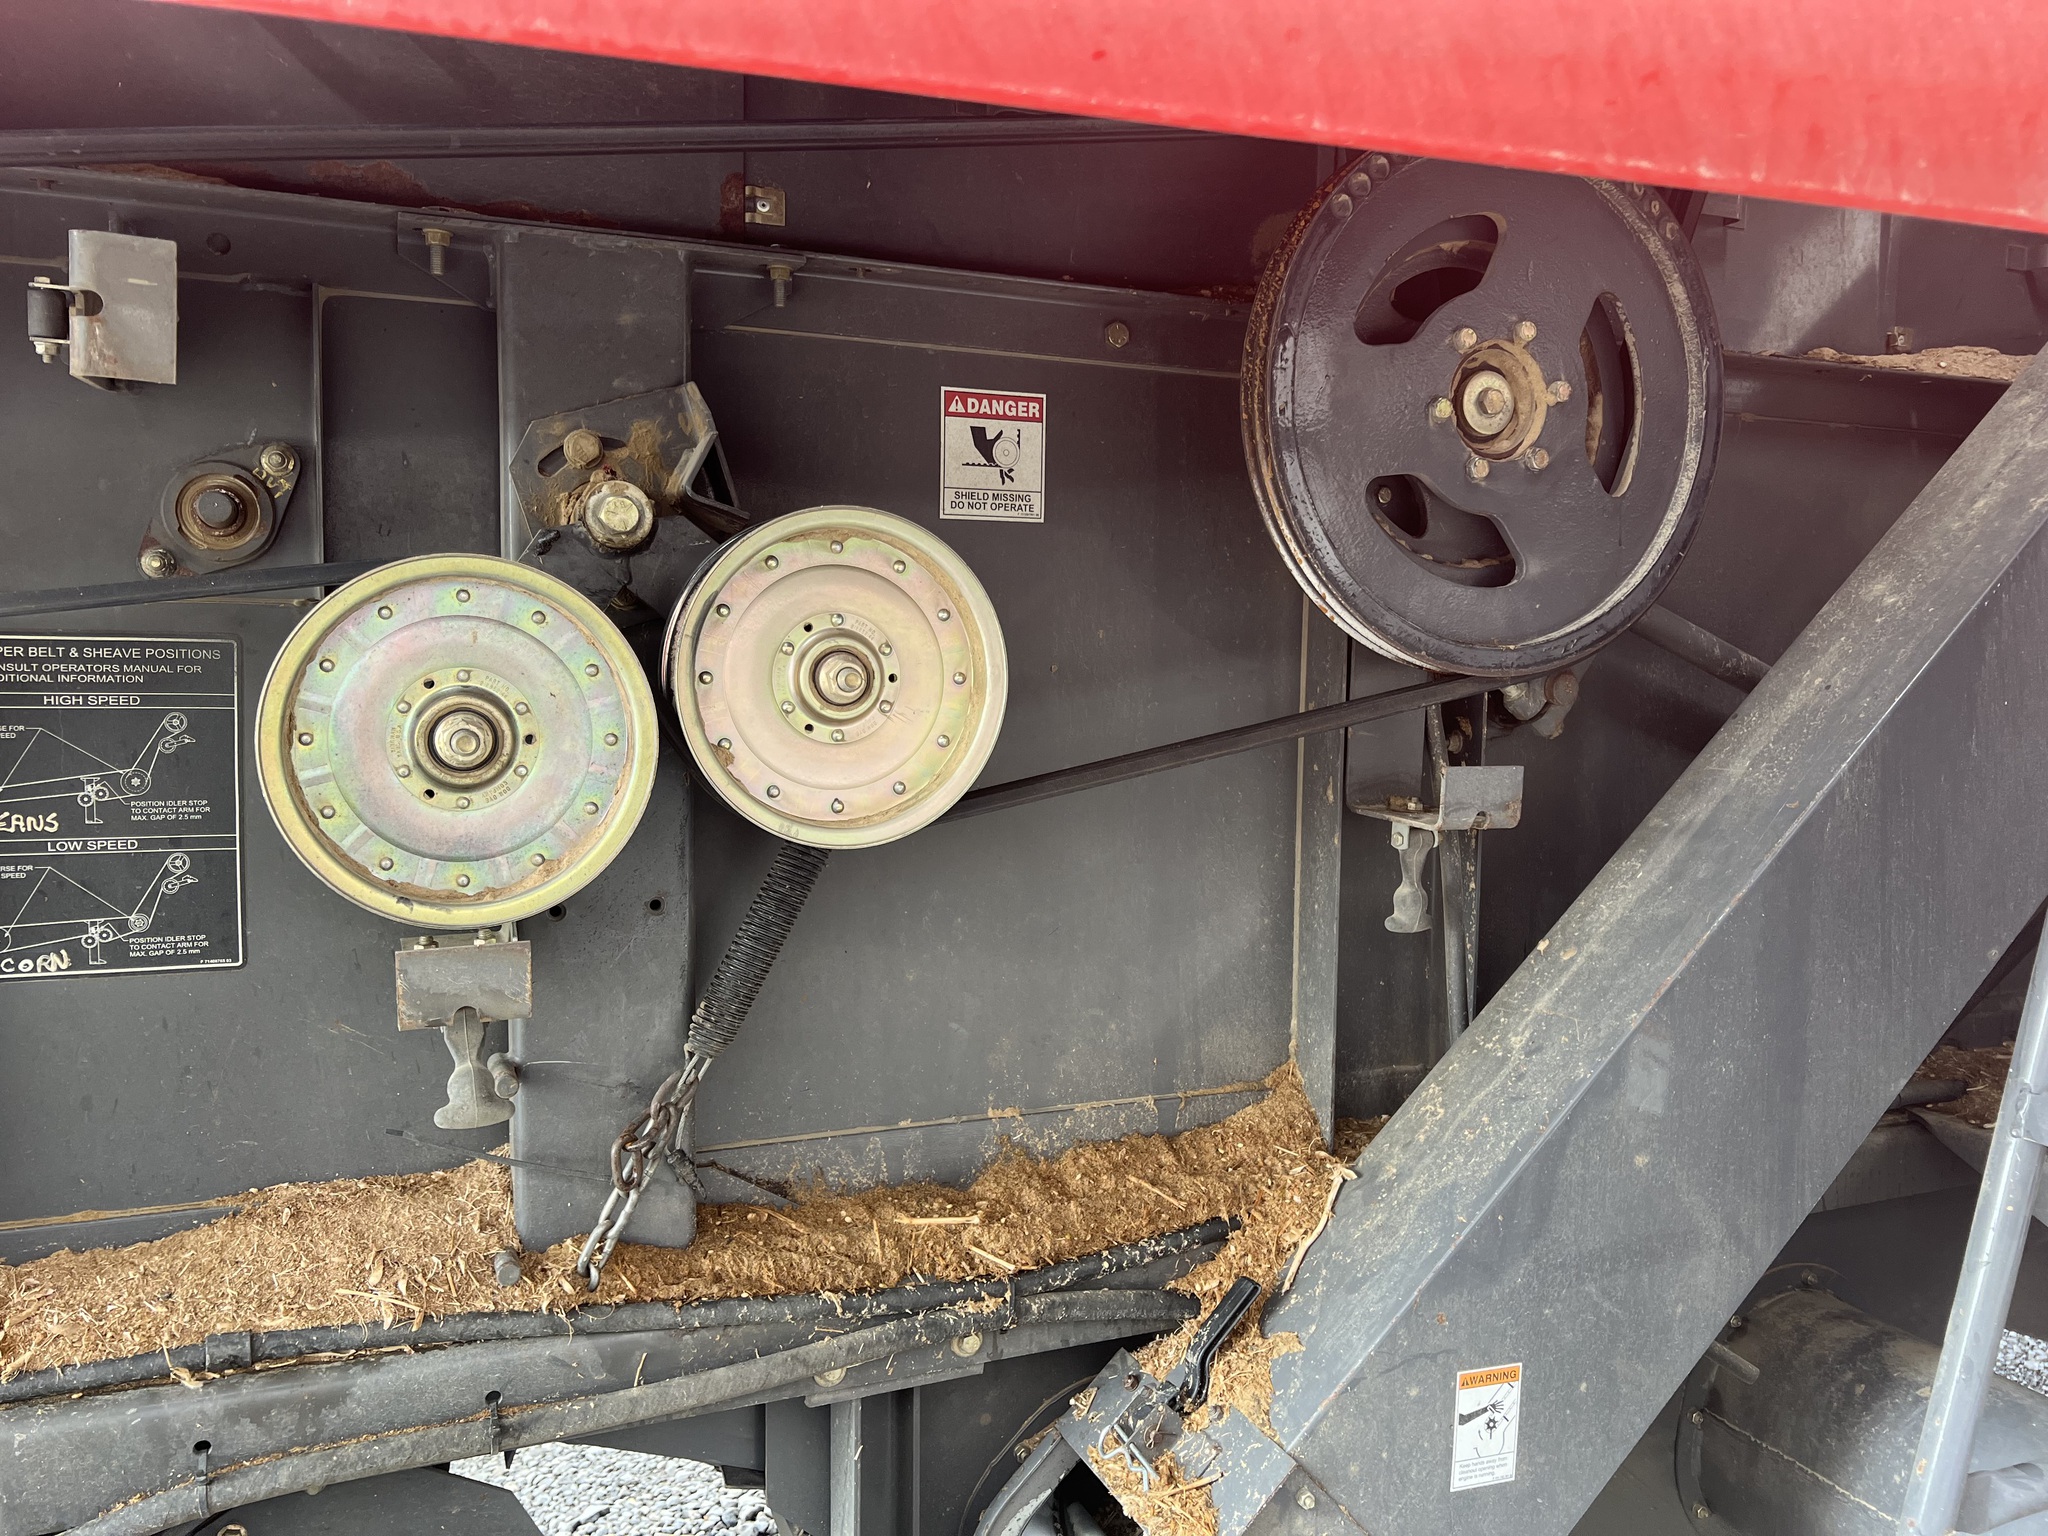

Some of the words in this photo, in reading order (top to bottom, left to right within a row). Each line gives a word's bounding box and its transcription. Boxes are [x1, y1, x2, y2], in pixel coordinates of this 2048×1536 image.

[967, 398, 1040, 418] DANGER
[954, 491, 989, 501] SHIELD
[992, 493, 1031, 503] MISSING
[950, 500, 964, 510] DO
[967, 502, 988, 511] NOT
[990, 502, 1035, 512] OPERATE
[28, 647, 65, 658] BELT
[69, 647, 79, 658] &
[83, 648, 141, 659] SHEAVE
[145, 648, 221, 660] POSITIONS
[42, 664, 120, 672] OPERATORS
[123, 664, 174, 673] MANUAL
[177, 665, 202, 674] FOR
[57, 675, 144, 683] INFORMATION
[43, 695, 83, 706] HIGH
[87, 695, 141, 706] SPEED
[47, 841, 83, 852] LOW
[87, 840, 138, 850] SPEED
[0, 949, 70, 973] CORN
[1470, 1370, 1517, 1384] WARNING
